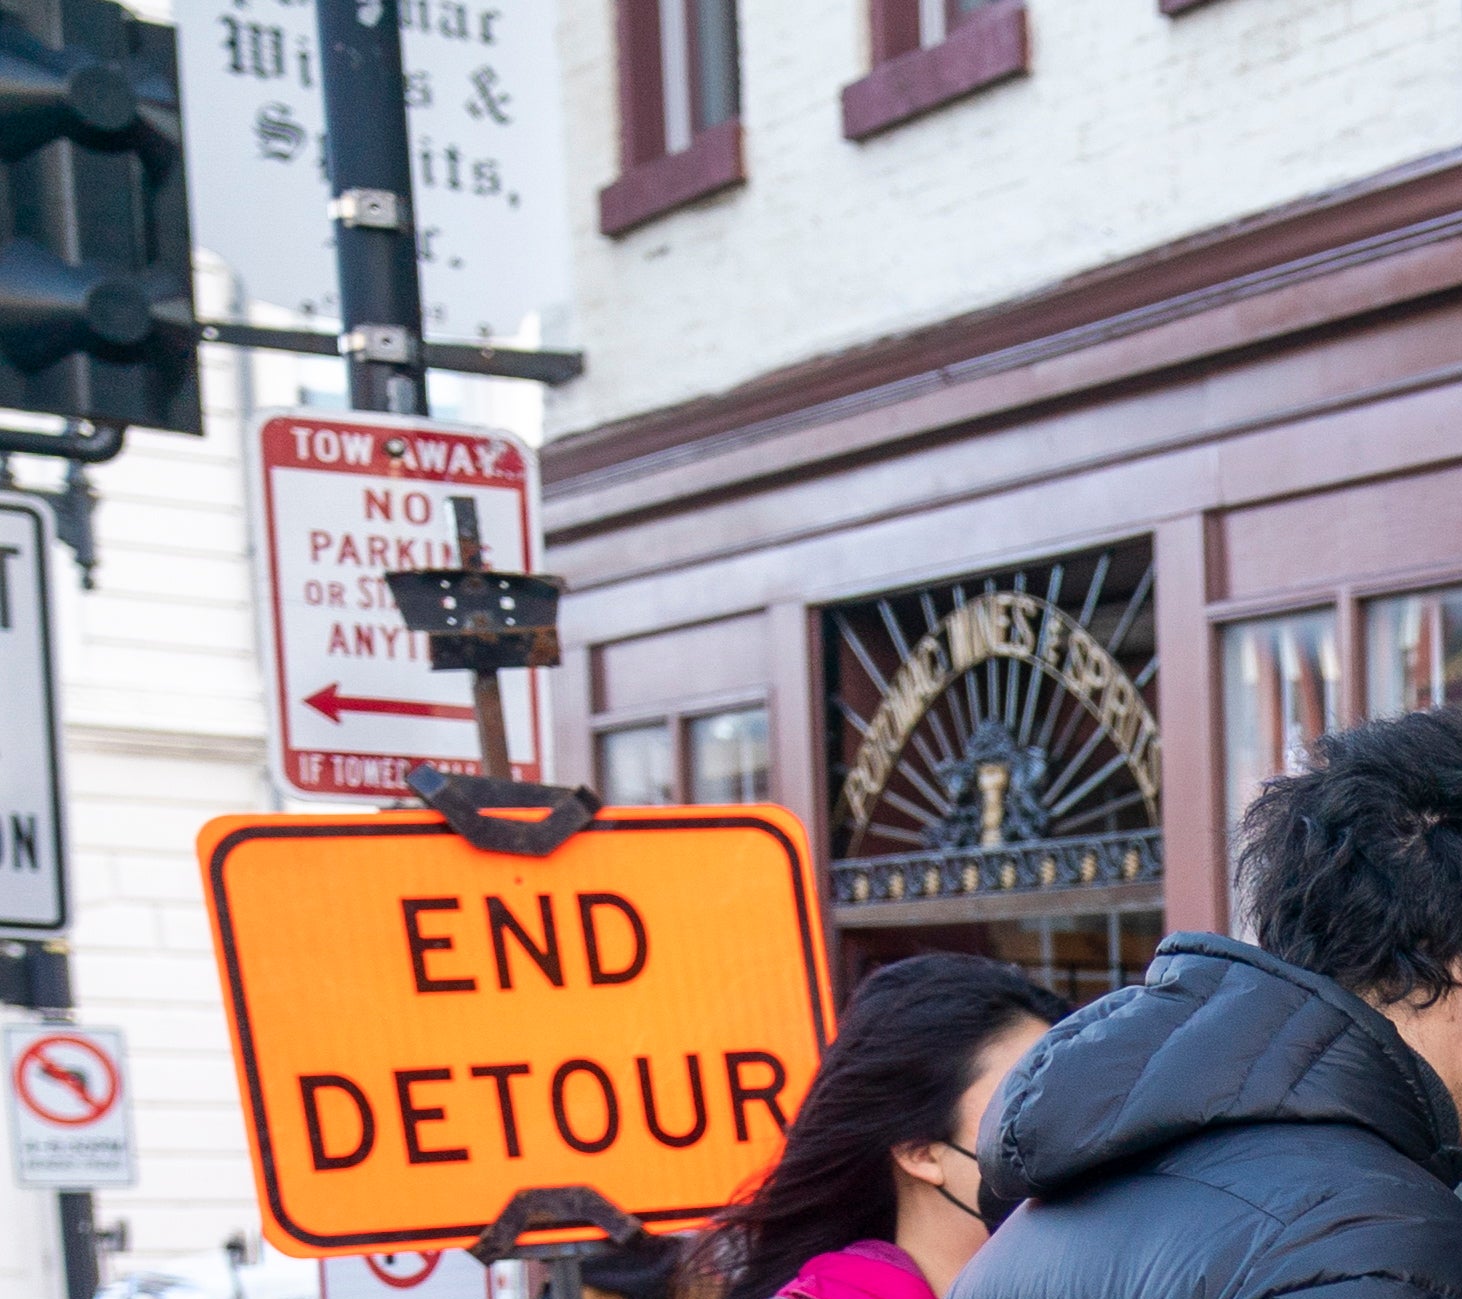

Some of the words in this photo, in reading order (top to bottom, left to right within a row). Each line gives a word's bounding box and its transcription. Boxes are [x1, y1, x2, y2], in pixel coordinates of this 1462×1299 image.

[219, 14, 435, 108] Wis
[464, 64, 515, 126] &
[289, 427, 374, 466] TOW
[363, 487, 432, 525] NO
[304, 578, 347, 609] OR
[298, 753, 323, 785] IF
[400, 893, 651, 995] END
[298, 1050, 794, 1173] DETOUR
